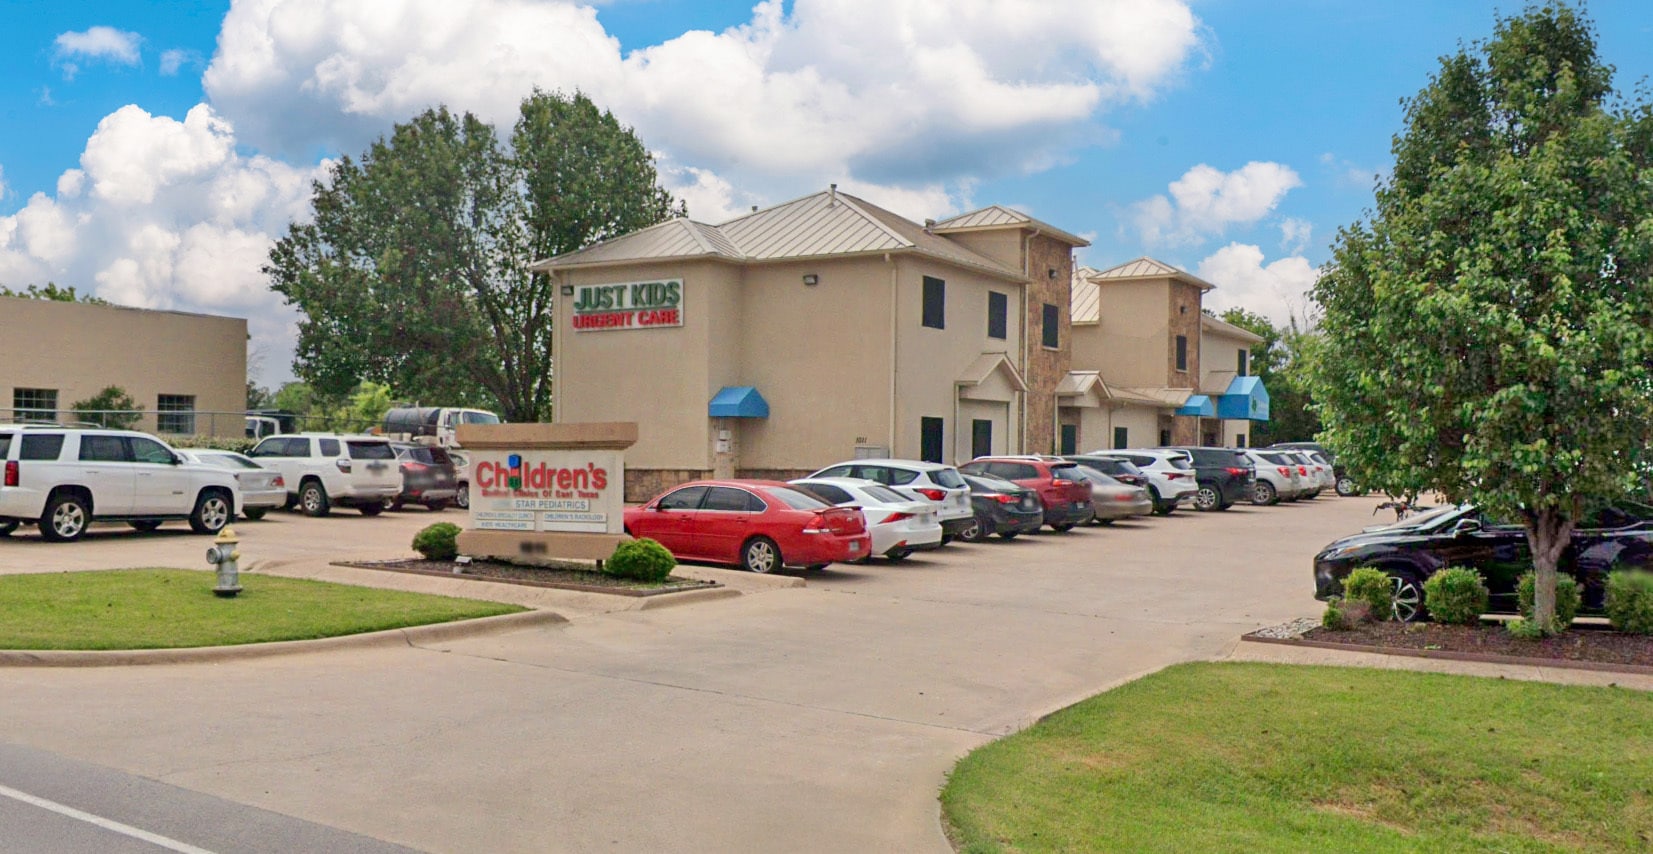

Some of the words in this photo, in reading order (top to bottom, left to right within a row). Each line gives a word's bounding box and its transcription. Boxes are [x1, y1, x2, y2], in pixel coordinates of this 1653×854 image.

[574, 285, 627, 310] JUST
[631, 281, 681, 307] KIDS
[573, 311, 634, 329] URGENT
[638, 309, 680, 326] CARE
[476, 456, 608, 490] Children's
[542, 490, 552, 498] Of
[555, 490, 573, 499] East
[577, 490, 599, 499] Texas
[515, 500, 536, 509] STAR
[538, 500, 587, 510] PEDIATRICS
